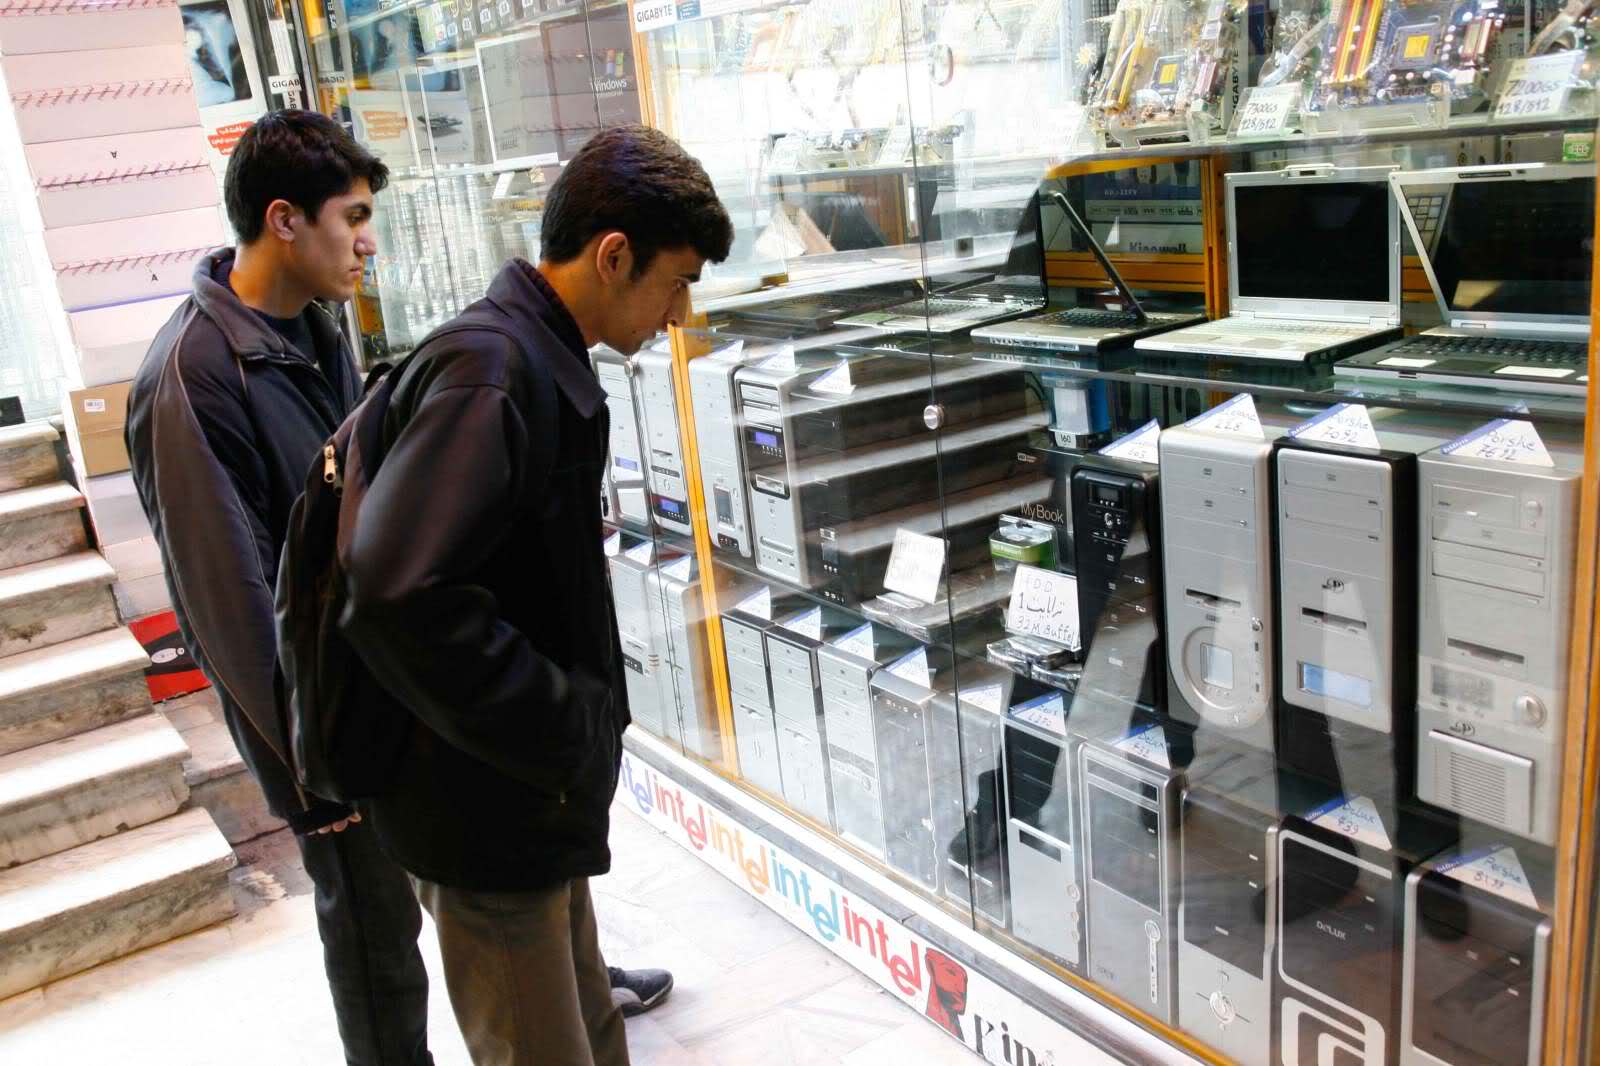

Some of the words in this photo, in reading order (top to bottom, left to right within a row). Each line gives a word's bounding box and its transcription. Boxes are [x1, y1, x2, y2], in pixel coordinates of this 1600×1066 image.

[636, 4, 673, 23] GIGABYTE
[652, 773, 708, 851] intel
[708, 810, 770, 895] intel
[770, 848, 840, 942] intel
[842, 895, 923, 997] intel
